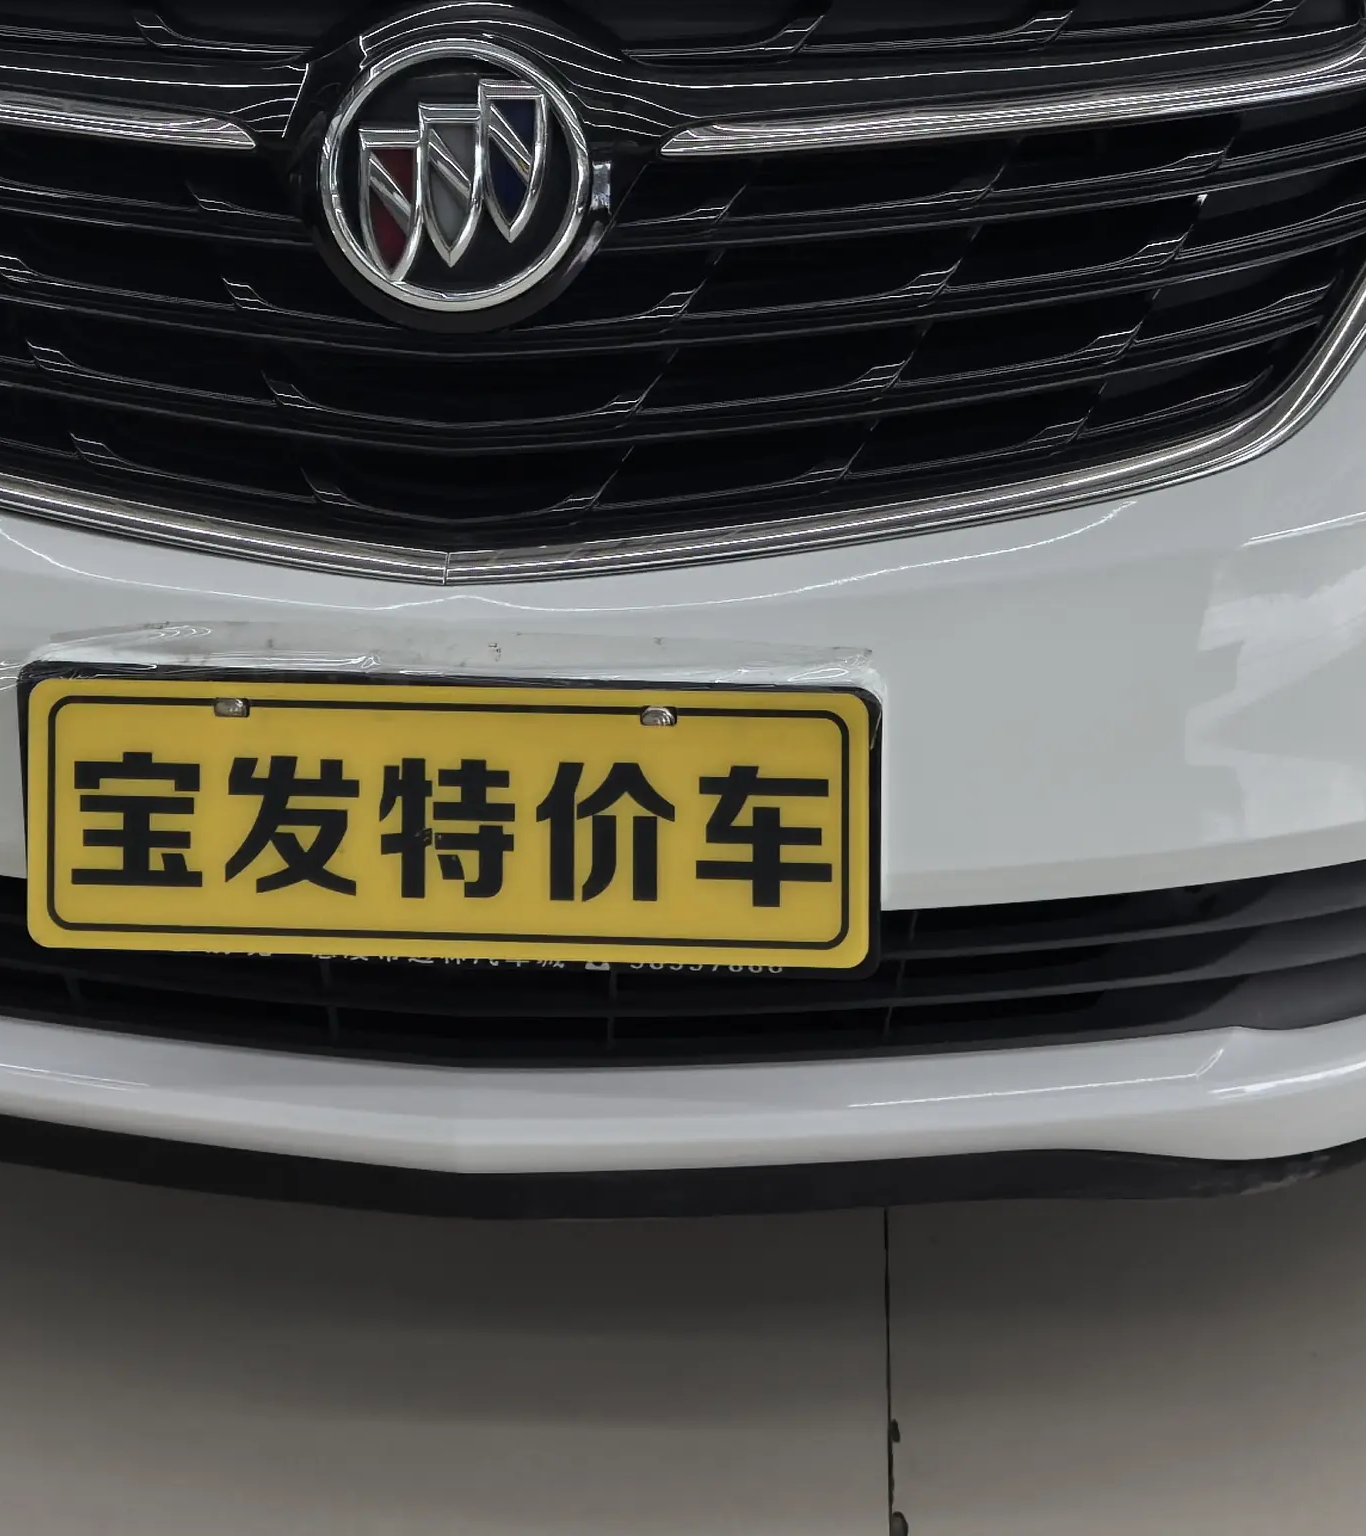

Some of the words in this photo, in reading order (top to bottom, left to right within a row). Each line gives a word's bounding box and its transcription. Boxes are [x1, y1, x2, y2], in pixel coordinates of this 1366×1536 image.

[71, 751, 833, 909] 宝发特价车
